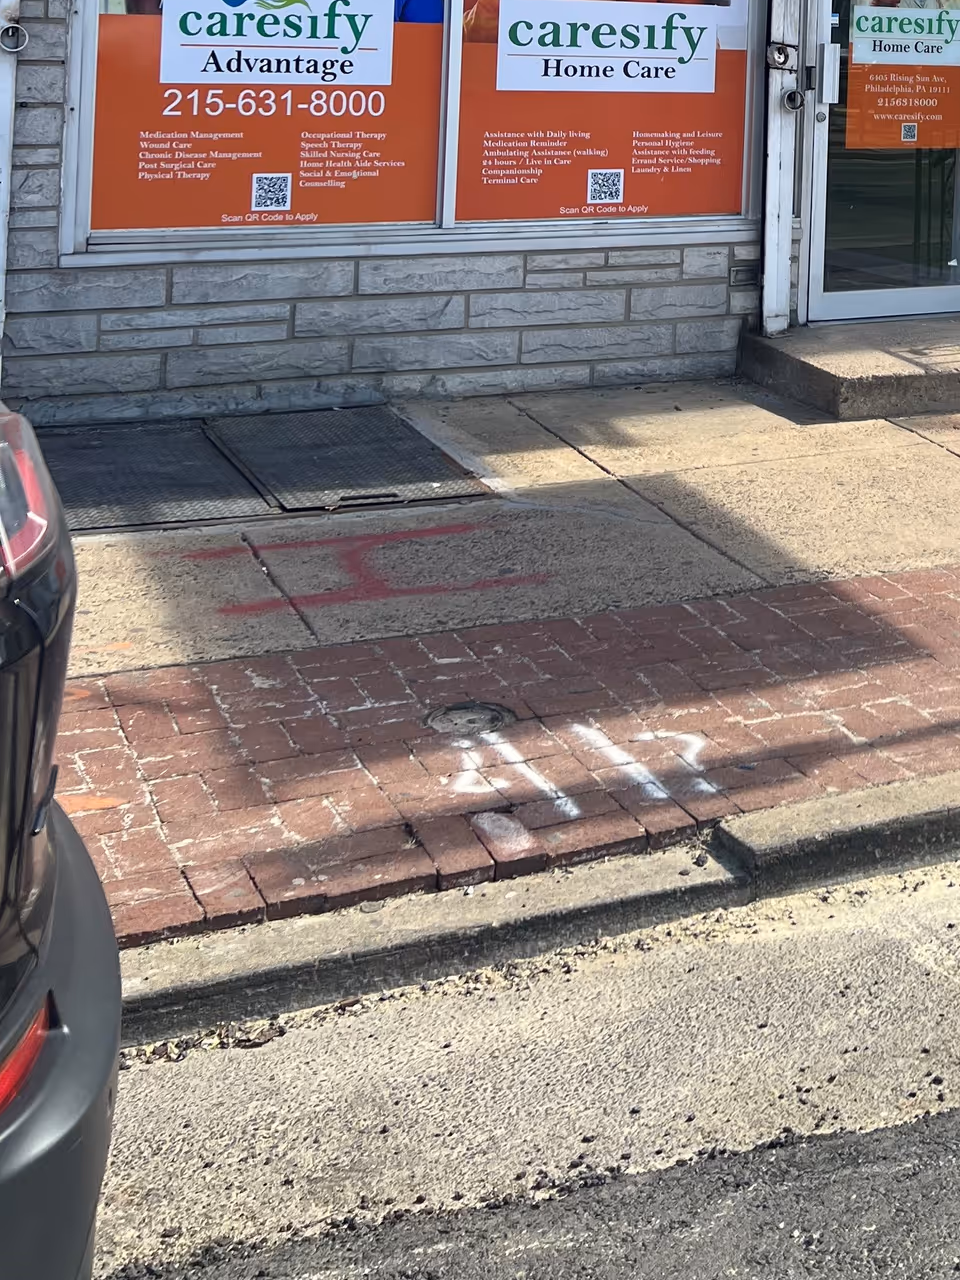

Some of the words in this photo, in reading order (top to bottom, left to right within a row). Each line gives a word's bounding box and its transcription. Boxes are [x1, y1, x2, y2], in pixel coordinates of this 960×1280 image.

[855, 10, 960, 45] caresify
[508, 12, 708, 64] caresify
[872, 40, 911, 53] Home
[914, 41, 943, 54] Care
[200, 49, 354, 82] Advantage
[541, 58, 615, 78] Home
[622, 59, 676, 79] Care
[890, 73, 914, 84] Rising
[915, 74, 930, 82] Sun
[932, 74, 947, 83] Ave,
[864, 84, 914, 95] Philadelphia,
[916, 85, 927, 93] PA
[929, 86, 950, 94] 19111
[162, 88, 386, 117] 215-631-8000
[877, 98, 938, 107] 2156318000
[873, 112, 943, 122] www.caresify.com
[139, 131, 188, 139] Medication
[190, 131, 244, 140] Management
[301, 131, 353, 140] Occupational
[354, 131, 387, 141] Therapy
[483, 130, 525, 138] Assistance
[527, 130, 544, 138] with
[546, 130, 567, 139] Daily
[569, 130, 591, 139] living
[632, 130, 680, 139] Homemaking
[682, 130, 695, 138] and
[697, 130, 723, 138] Leisure
[139, 141, 171, 149] Wound
[172, 141, 193, 149] Care
[300, 141, 328, 150] Speech
[330, 140, 363, 150] Therapy
[632, 139, 664, 147] Personal
[665, 139, 695, 148] Hygiene
[138, 151, 172, 159] Chronic
[174, 151, 207, 159] Disease
[209, 150, 263, 160] Management
[300, 150, 328, 158] Skilled
[330, 150, 361, 160] Nursing
[362, 150, 381, 158] Care
[482, 149, 529, 158] Ambulating
[531, 149, 572, 157] Assistance
[573, 148, 609, 158] (walking)
[632, 148, 670, 156] Assistance
[671, 148, 687, 156] with
[689, 148, 716, 157] feeding
[138, 161, 158, 169] Post
[159, 161, 195, 170] Surgical
[196, 161, 216, 169] Care
[300, 160, 324, 168] Home
[325, 160, 352, 168] Health
[354, 160, 372, 168] Aide
[373, 159, 406, 168] Services
[494, 158, 517, 166] hours
[526, 158, 543, 166] Live
[553, 157, 572, 165] Care
[299, 170, 323, 178] Social
[324, 170, 332, 178] &
[482, 167, 543, 177] Companionship
[631, 166, 661, 174] Laundry
[138, 171, 174, 181] Physical
[175, 171, 211, 181] Therapy
[520, 176, 539, 184] Care
[299, 179, 346, 188] Counselling
[559, 206, 580, 214] Scan
[581, 206, 595, 214] QR
[596, 205, 617, 214] Code
[618, 205, 626, 213] to
[627, 204, 649, 214] Apply
[221, 213, 243, 222] Scan
[245, 213, 259, 222] QR
[261, 212, 283, 222] Code
[285, 212, 294, 221] to
[295, 212, 318, 222] Apply
